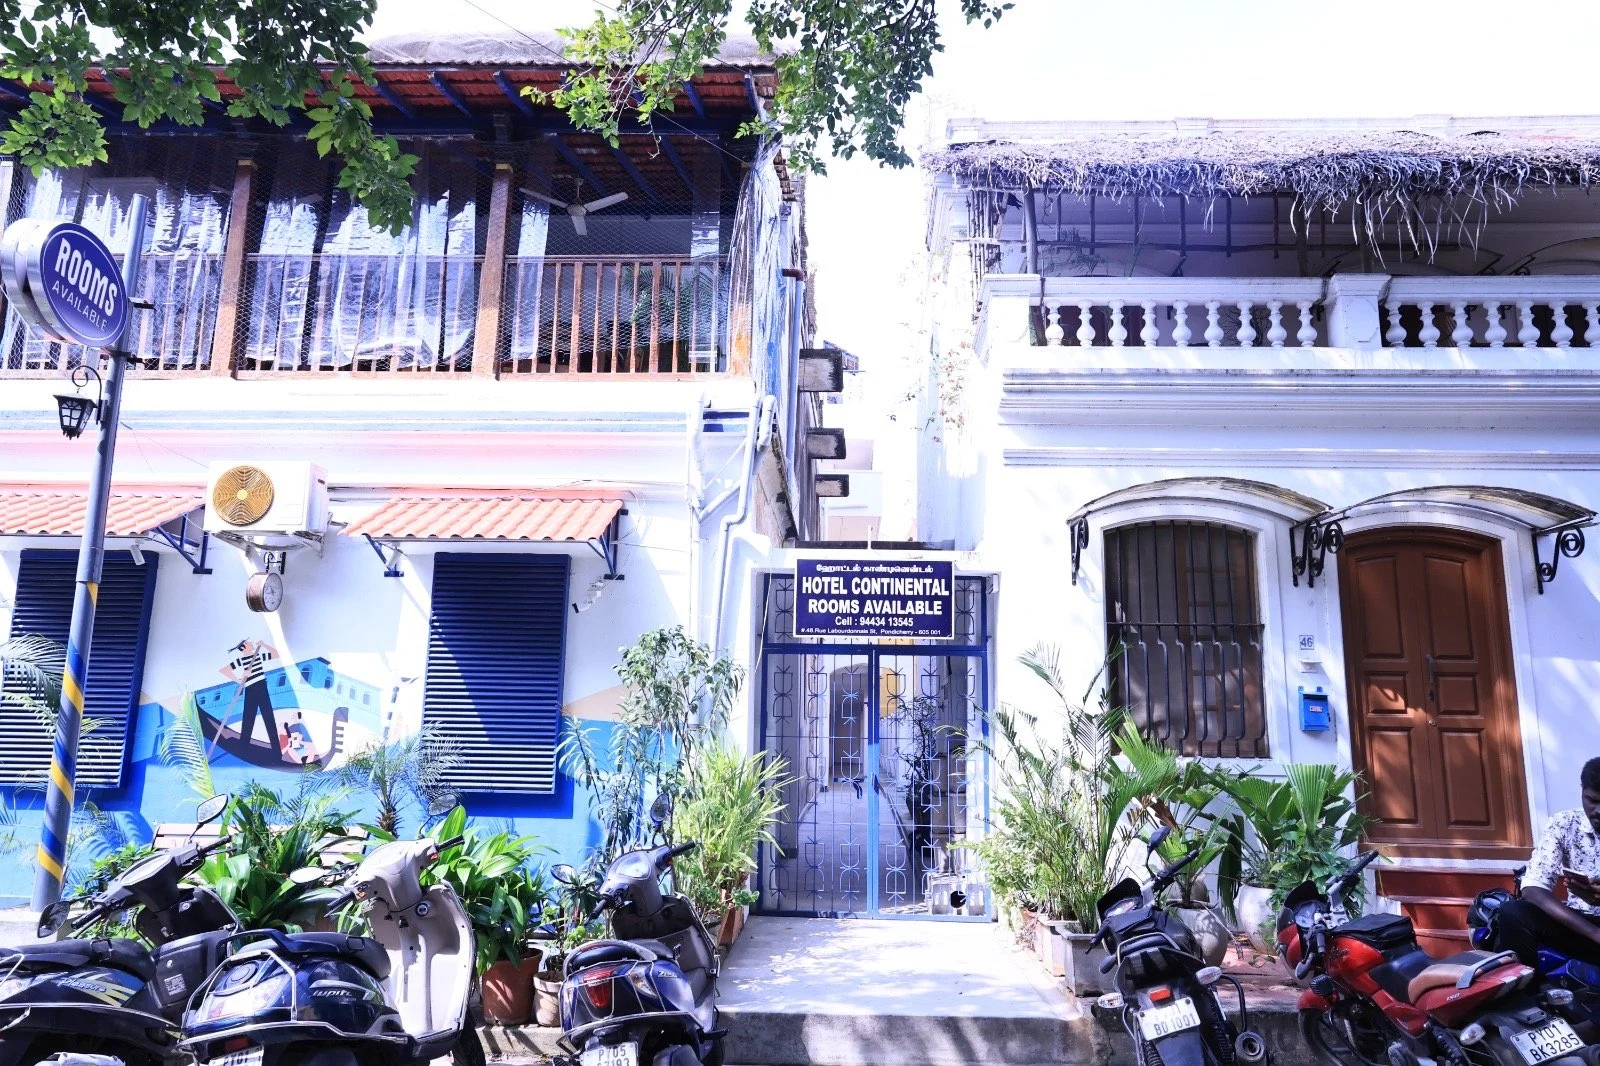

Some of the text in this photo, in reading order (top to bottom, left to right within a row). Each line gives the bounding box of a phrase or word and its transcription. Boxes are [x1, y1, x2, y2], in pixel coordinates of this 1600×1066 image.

[55, 238, 117, 316] ROOMS
[52, 280, 107, 331] AVAILABLE
[802, 576, 950, 596] HOTEL CONTINENTAL
[808, 599, 943, 615] ROOMS AVAILABLE
[835, 616, 852, 626] Cell
[859, 617, 886, 626] 94434
[888, 618, 914, 627] 13545
[880, 628, 914, 636] Pondicherry
[1300, 637, 1313, 647] 46
[57, 978, 107, 993] Pleasure
[1528, 1023, 1561, 1045] PY01
[1530, 1033, 1580, 1062] BK3285
